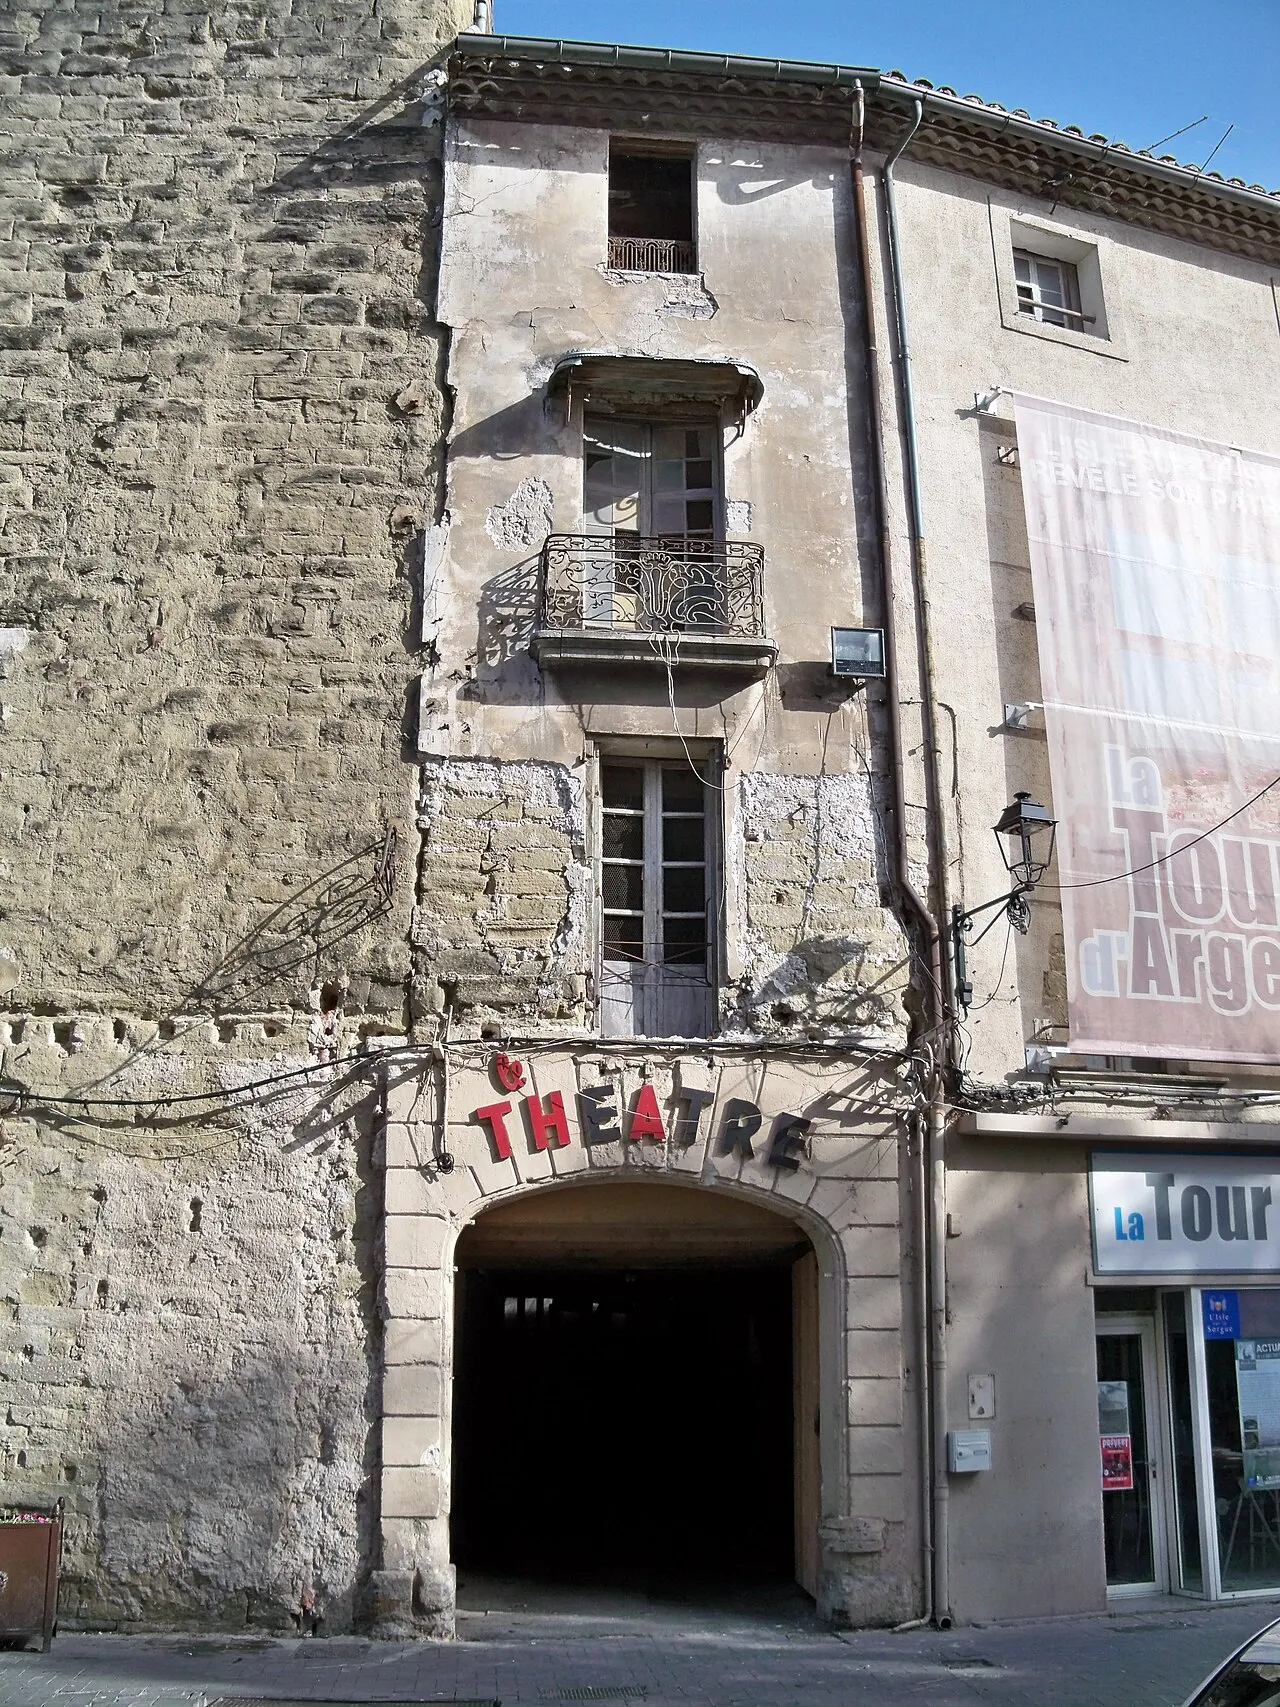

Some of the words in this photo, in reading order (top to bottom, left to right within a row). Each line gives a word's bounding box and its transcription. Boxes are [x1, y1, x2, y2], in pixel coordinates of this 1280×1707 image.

[1110, 806, 1280, 930] Tou
[477, 1084, 812, 1170] THEATRE
[1114, 1207, 1145, 1240] La
[1145, 1173, 1272, 1241] Tour
[1207, 1326, 1233, 1335] Sorgue
